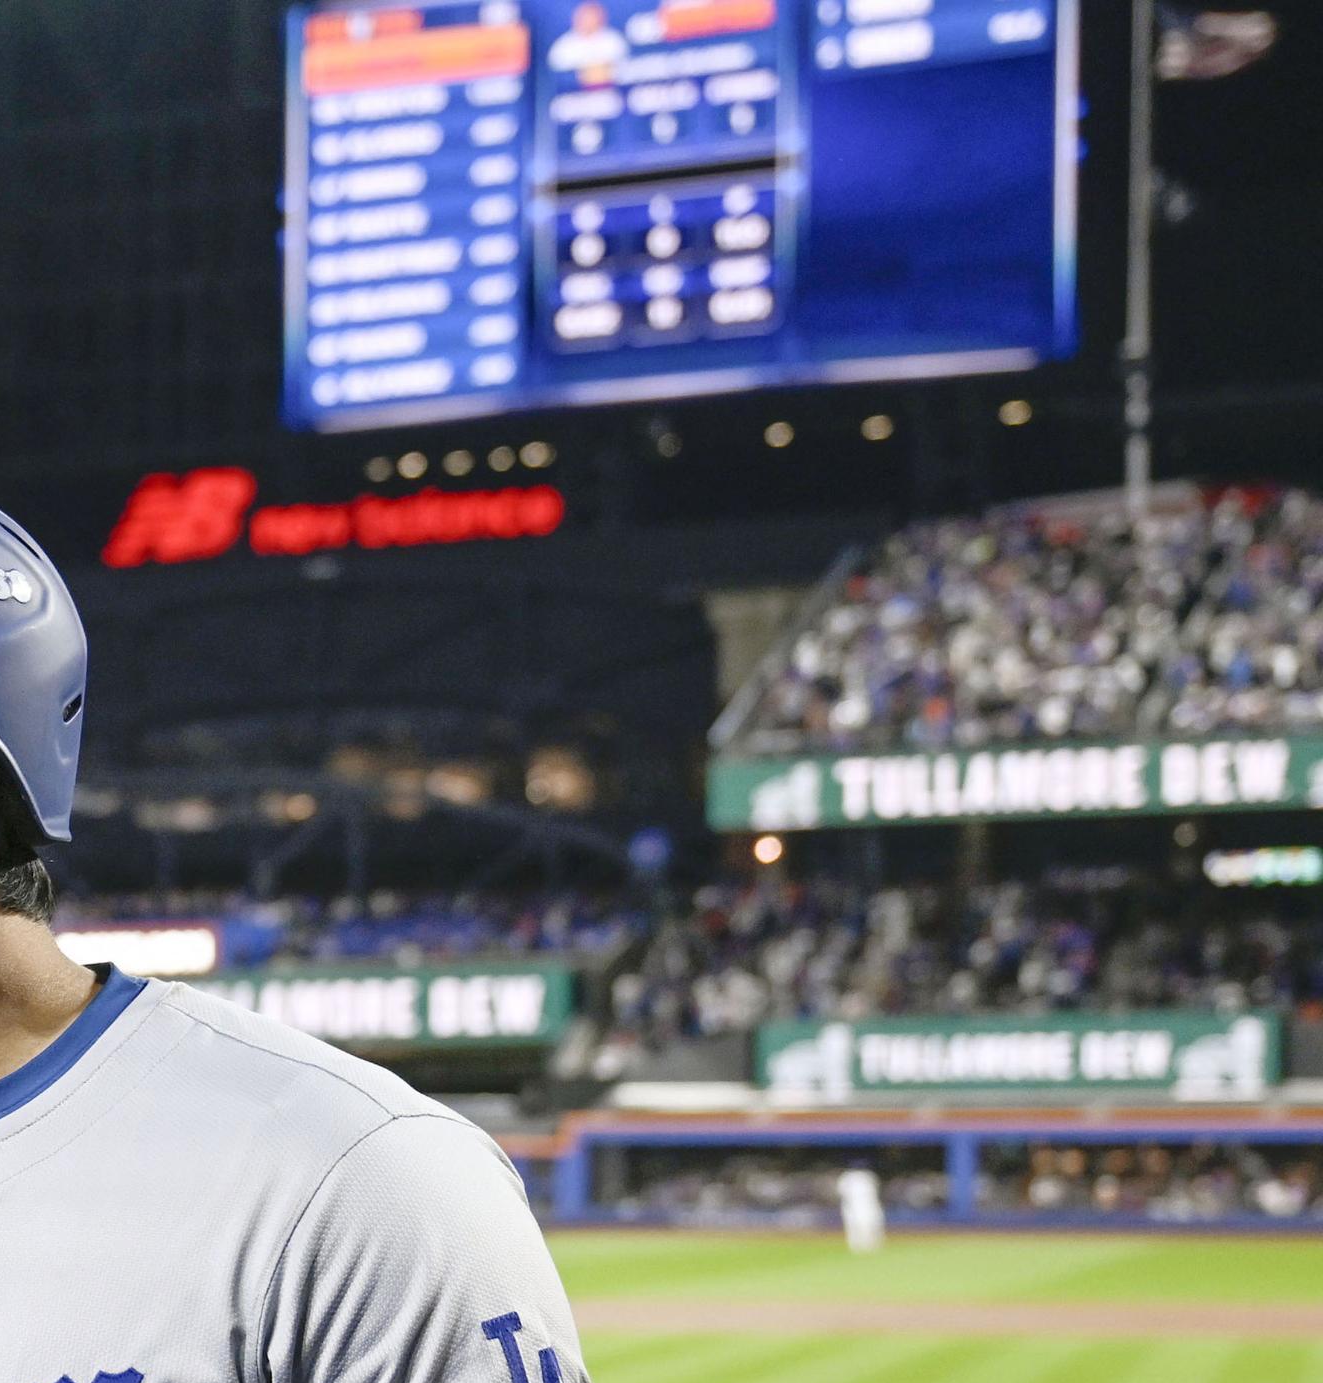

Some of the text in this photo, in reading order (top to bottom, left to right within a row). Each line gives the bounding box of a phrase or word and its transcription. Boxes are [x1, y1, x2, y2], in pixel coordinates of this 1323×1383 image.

[833, 740, 1292, 821] TULLAMORE DEW
[428, 974, 546, 1036] DEW
[859, 1030, 1173, 1084] TULLAMORE DEW
